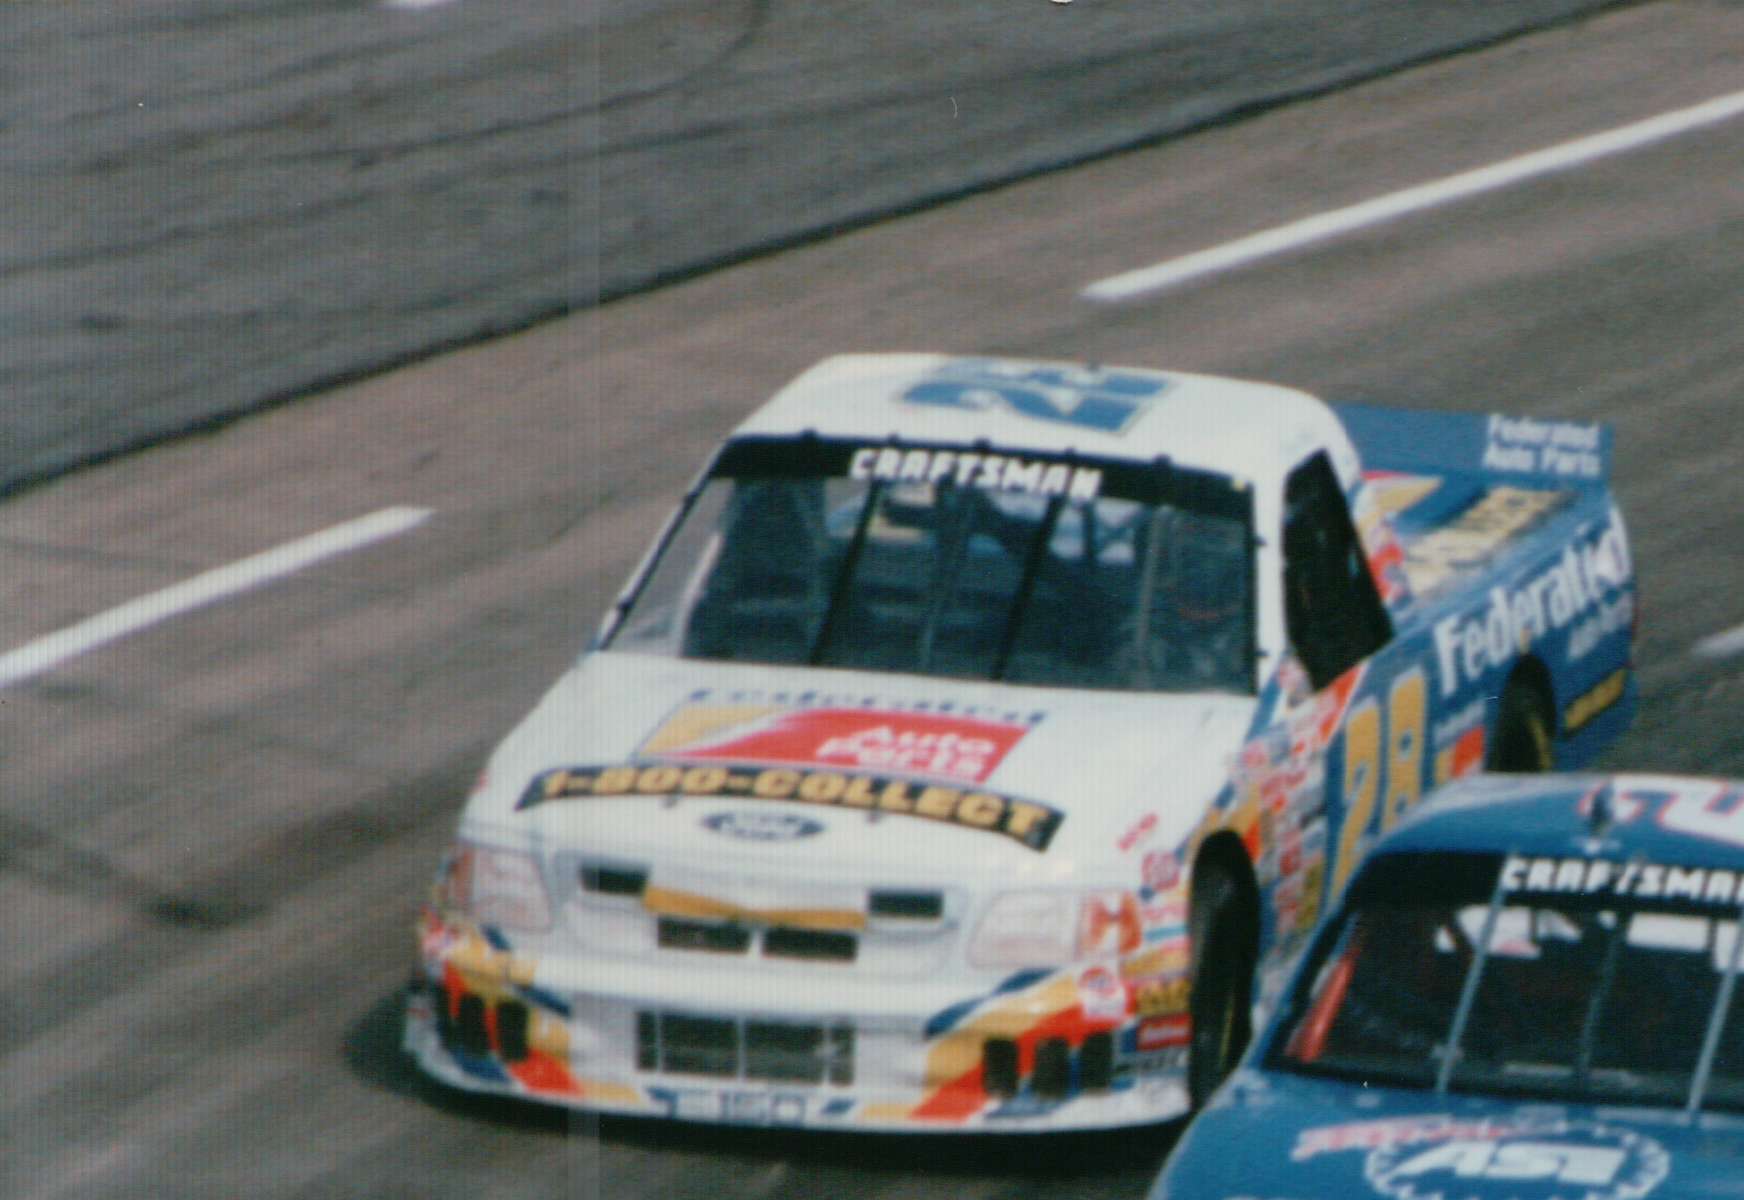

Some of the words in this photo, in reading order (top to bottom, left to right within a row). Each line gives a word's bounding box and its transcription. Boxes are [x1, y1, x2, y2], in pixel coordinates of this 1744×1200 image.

[849, 447, 1103, 502] CRAFTSMAN
[816, 738, 986, 776] Parts
[857, 725, 996, 758] Auto
[543, 764, 1052, 840] 1-800-COLLECT
